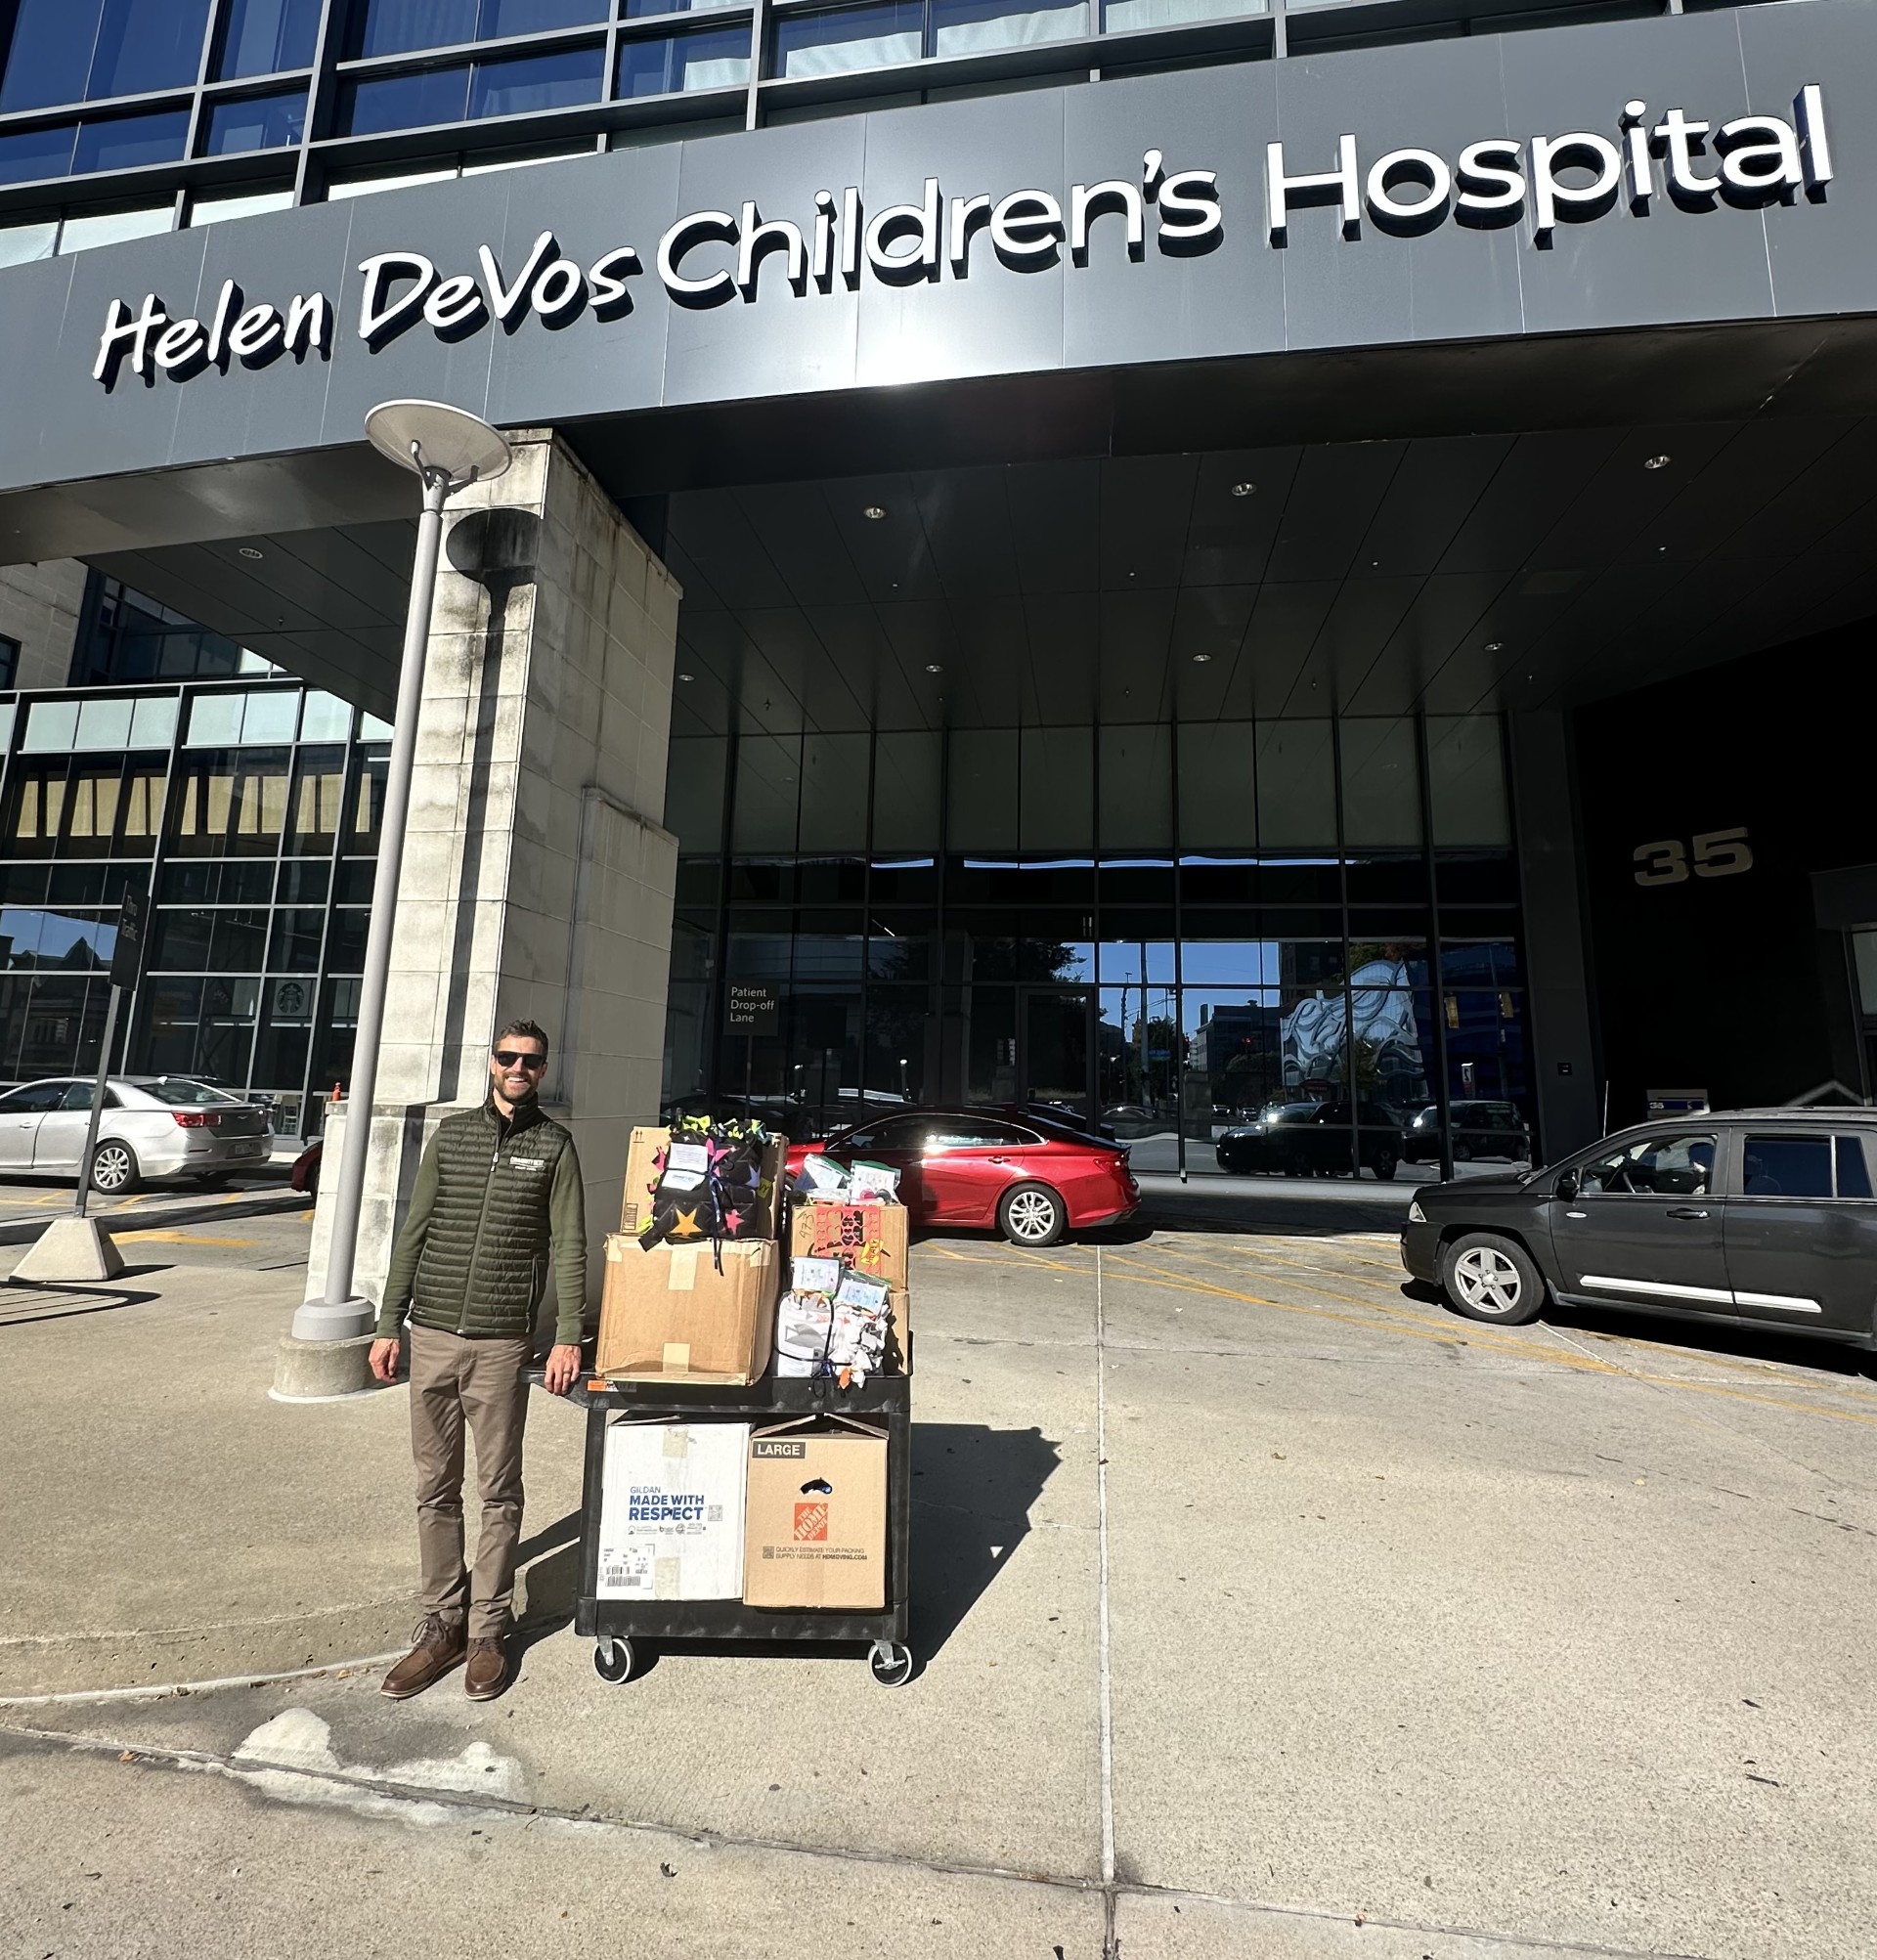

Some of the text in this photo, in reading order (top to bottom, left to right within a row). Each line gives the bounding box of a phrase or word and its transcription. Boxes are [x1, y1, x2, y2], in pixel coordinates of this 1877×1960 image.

[92, 83, 1834, 382] Helen DeVos Children's Hospital
[1633, 826, 1754, 887] 35
[731, 986, 767, 997] Patient
[730, 999, 775, 1012] Drop-off
[730, 1012, 755, 1023] Lane
[757, 1444, 801, 1456] LARGE
[630, 1495, 705, 1505] MADE WITH
[629, 1506, 704, 1521] RESPECT
[798, 1506, 812, 1522] THE
[794, 1503, 828, 1541] HOME
